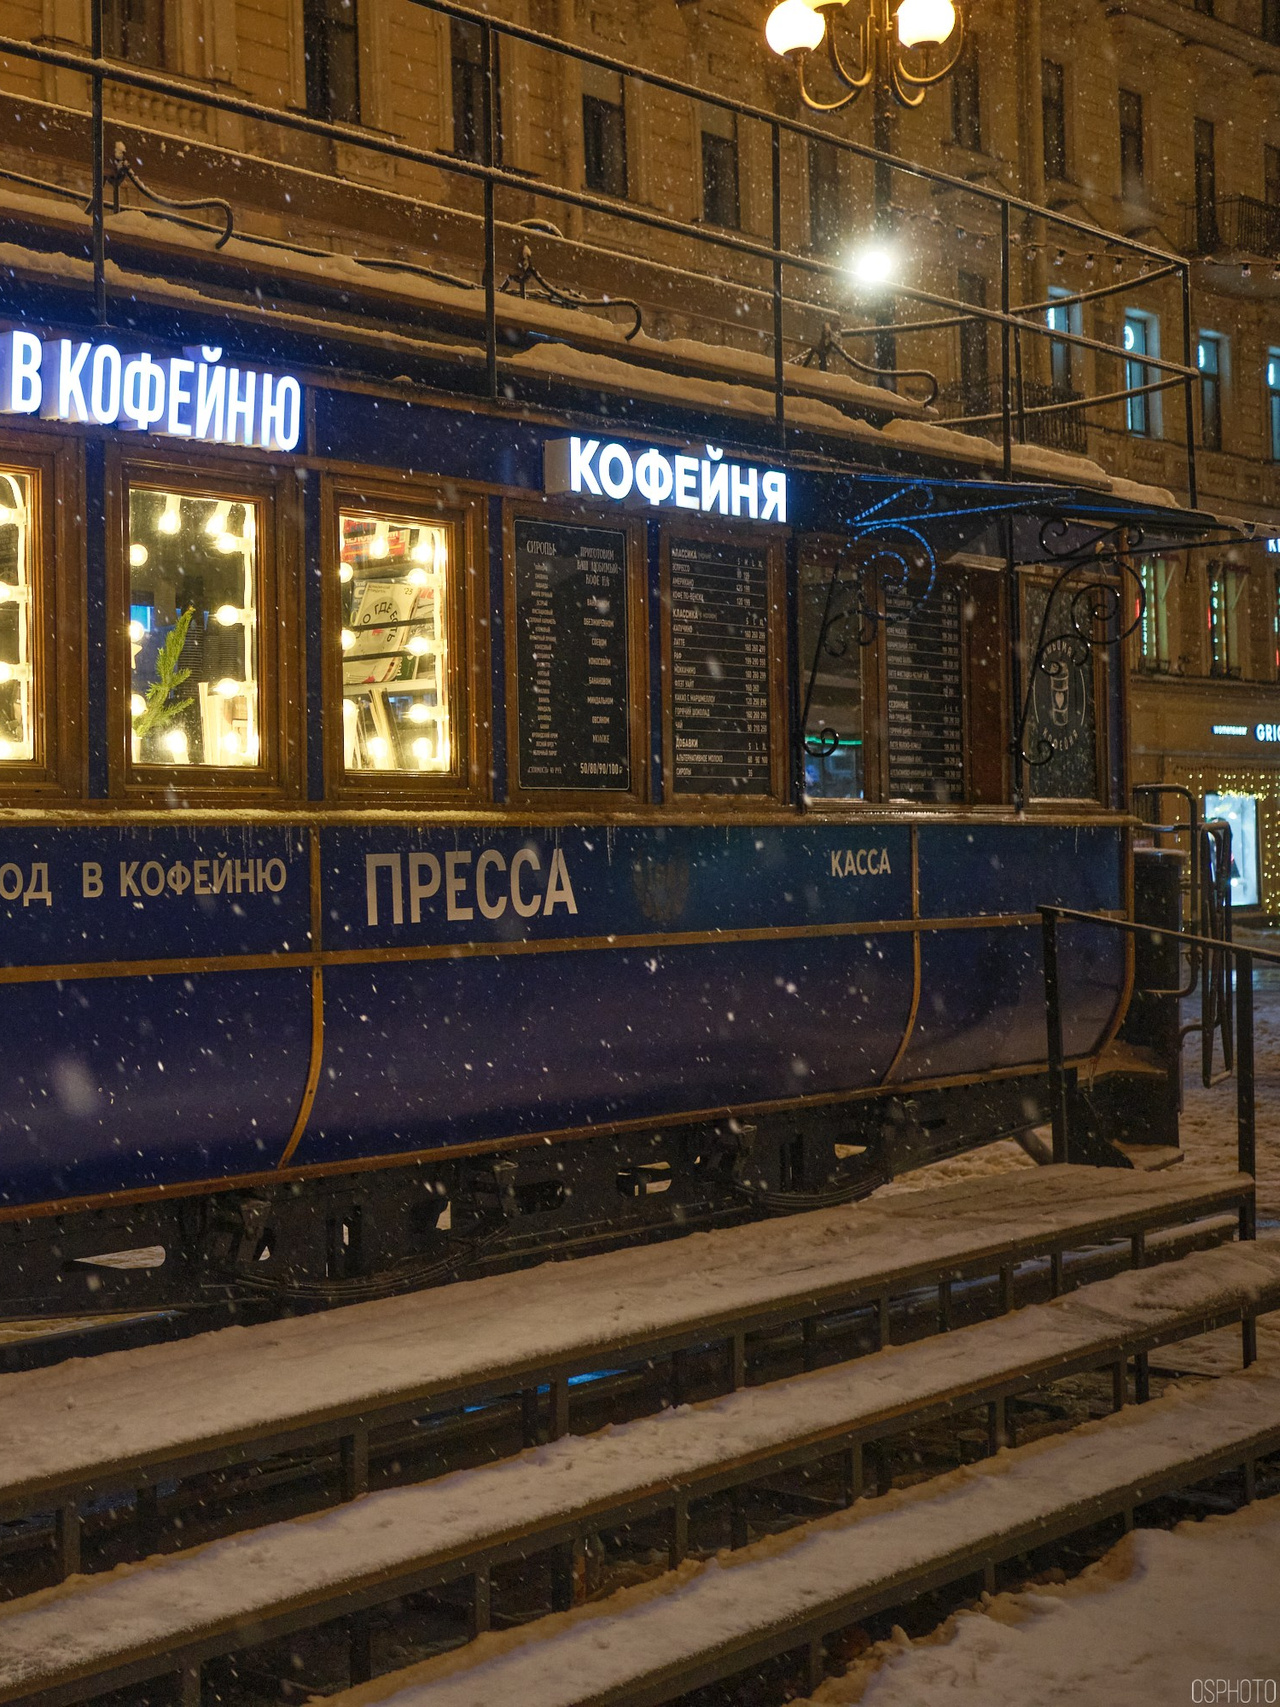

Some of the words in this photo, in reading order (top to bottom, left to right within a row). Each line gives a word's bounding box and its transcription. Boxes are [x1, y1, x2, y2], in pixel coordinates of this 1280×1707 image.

[11, 330, 43, 414] В
[58, 344, 301, 451] КОФЕЙНЮ
[569, 436, 787, 523] КОФЕЙНЯ
[526, 540, 557, 556] СИРОПЫ
[580, 546, 615, 560] ПРИГОТОВИМ
[374, 601, 393, 615] ГДЕ
[672, 608, 698, 619] КЛАССИКА
[675, 738, 699, 749] ДОБАВКИ
[830, 848, 893, 878] КАССА
[82, 861, 105, 899] В
[119, 852, 288, 898] КОФЕЙНЮ
[365, 848, 579, 927] ПРЕССА
